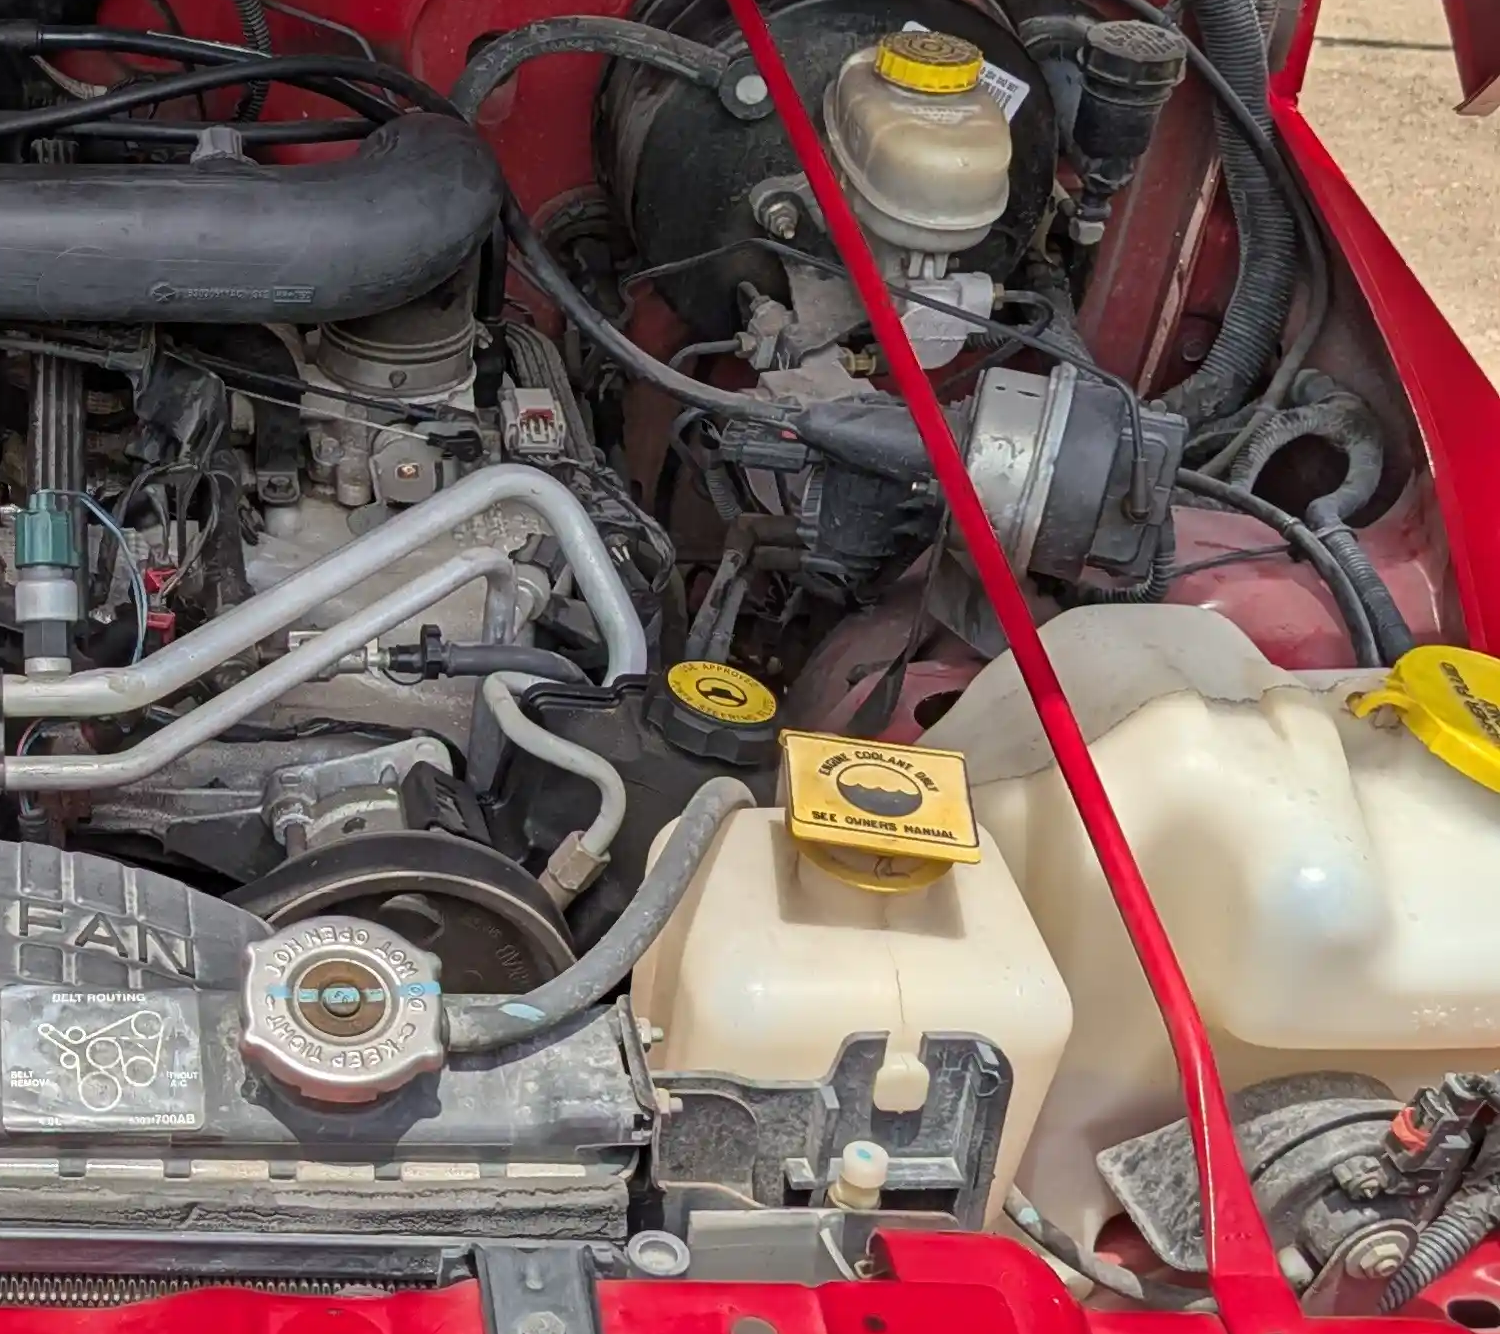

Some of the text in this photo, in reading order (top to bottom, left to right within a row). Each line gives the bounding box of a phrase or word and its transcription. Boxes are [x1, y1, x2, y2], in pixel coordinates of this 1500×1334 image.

[818, 750, 941, 794] ENGINE COOLANT ONLY
[811, 810, 959, 841] SEE OWNERS MANUAL
[18, 900, 196, 980] FAN
[303, 924, 371, 949] OPEN
[264, 936, 305, 980] HOT
[373, 939, 420, 980] NOT
[51, 992, 146, 1003] BELT ROUTING
[264, 1014, 401, 1070] KEEP TIGHT
[10, 1070, 34, 1079] BELT
